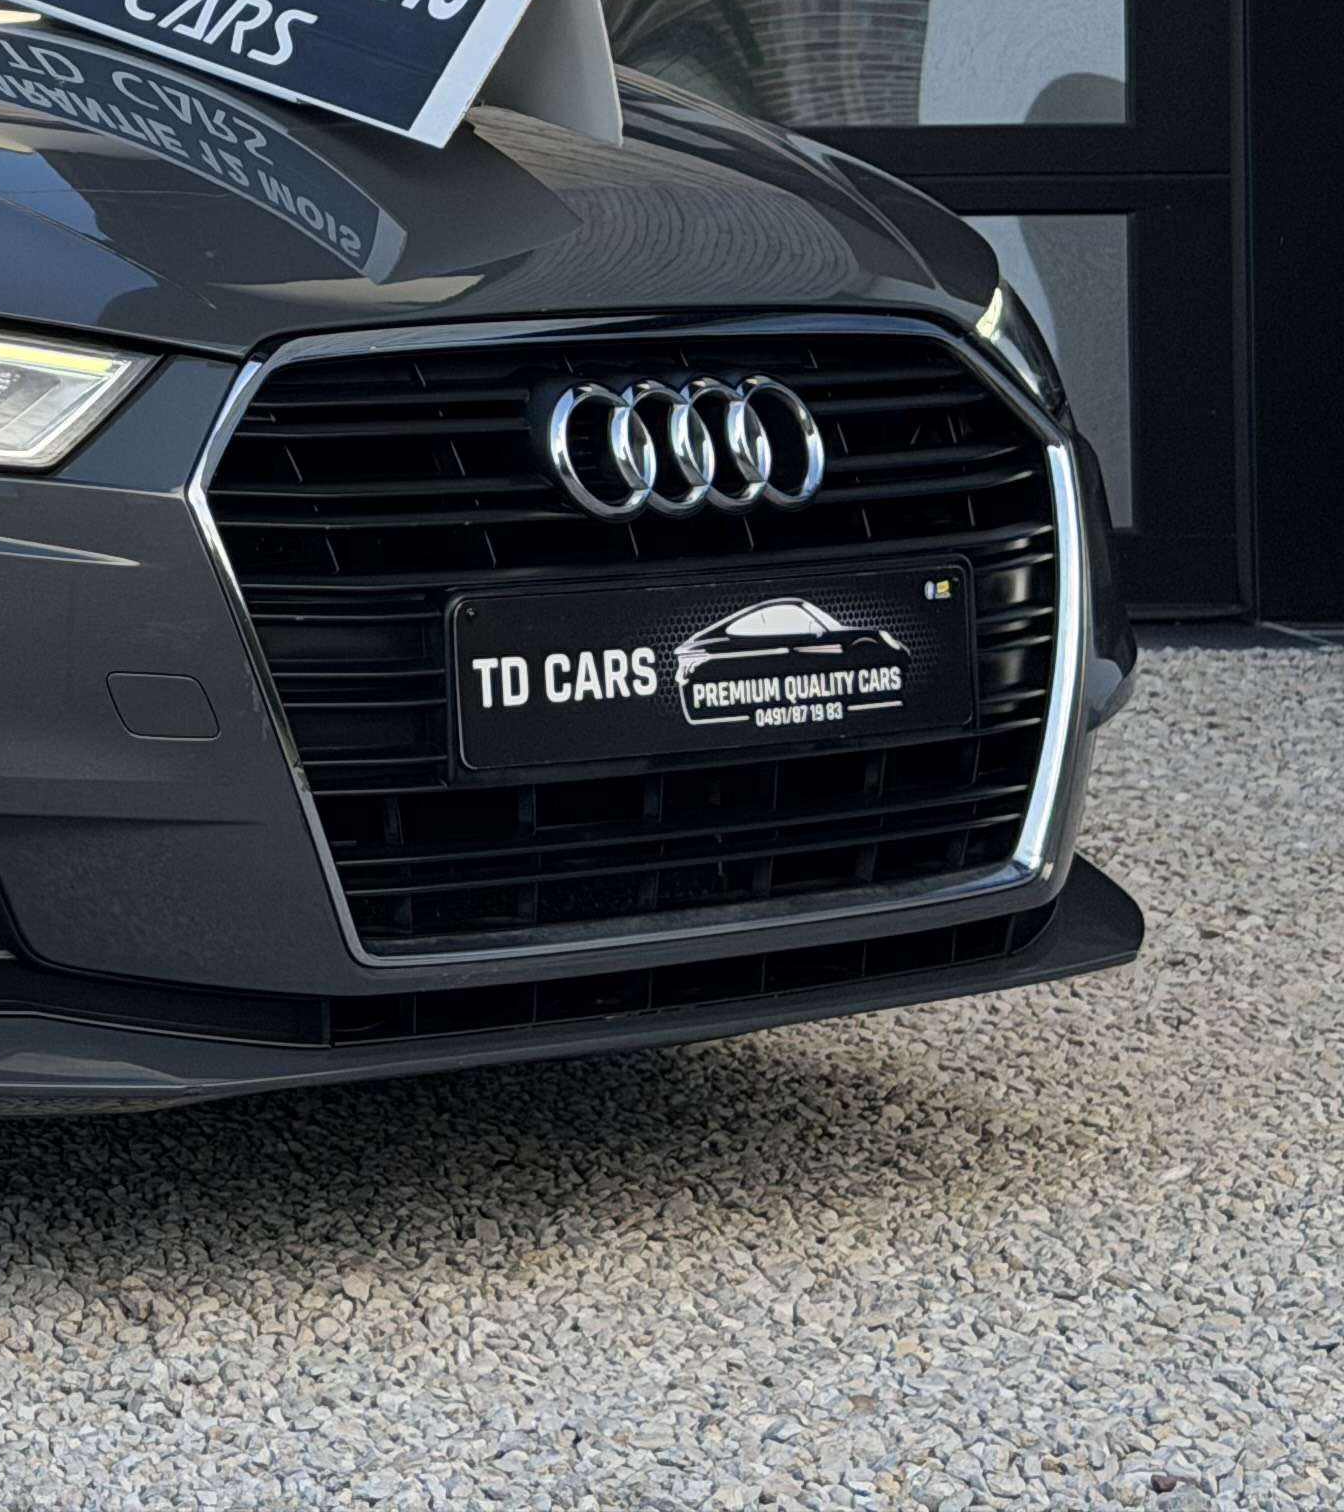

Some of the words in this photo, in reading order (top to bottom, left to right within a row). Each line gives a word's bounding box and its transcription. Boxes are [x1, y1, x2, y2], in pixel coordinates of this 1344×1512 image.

[472, 657, 529, 708] TD
[544, 647, 658, 703] CARS
[692, 676, 781, 709] PREMIUM
[784, 670, 855, 705] QUALITY
[858, 666, 902, 694] CARS
[755, 704, 808, 727] 0491/87
[810, 703, 825, 722] 19
[825, 701, 843, 721] 83
